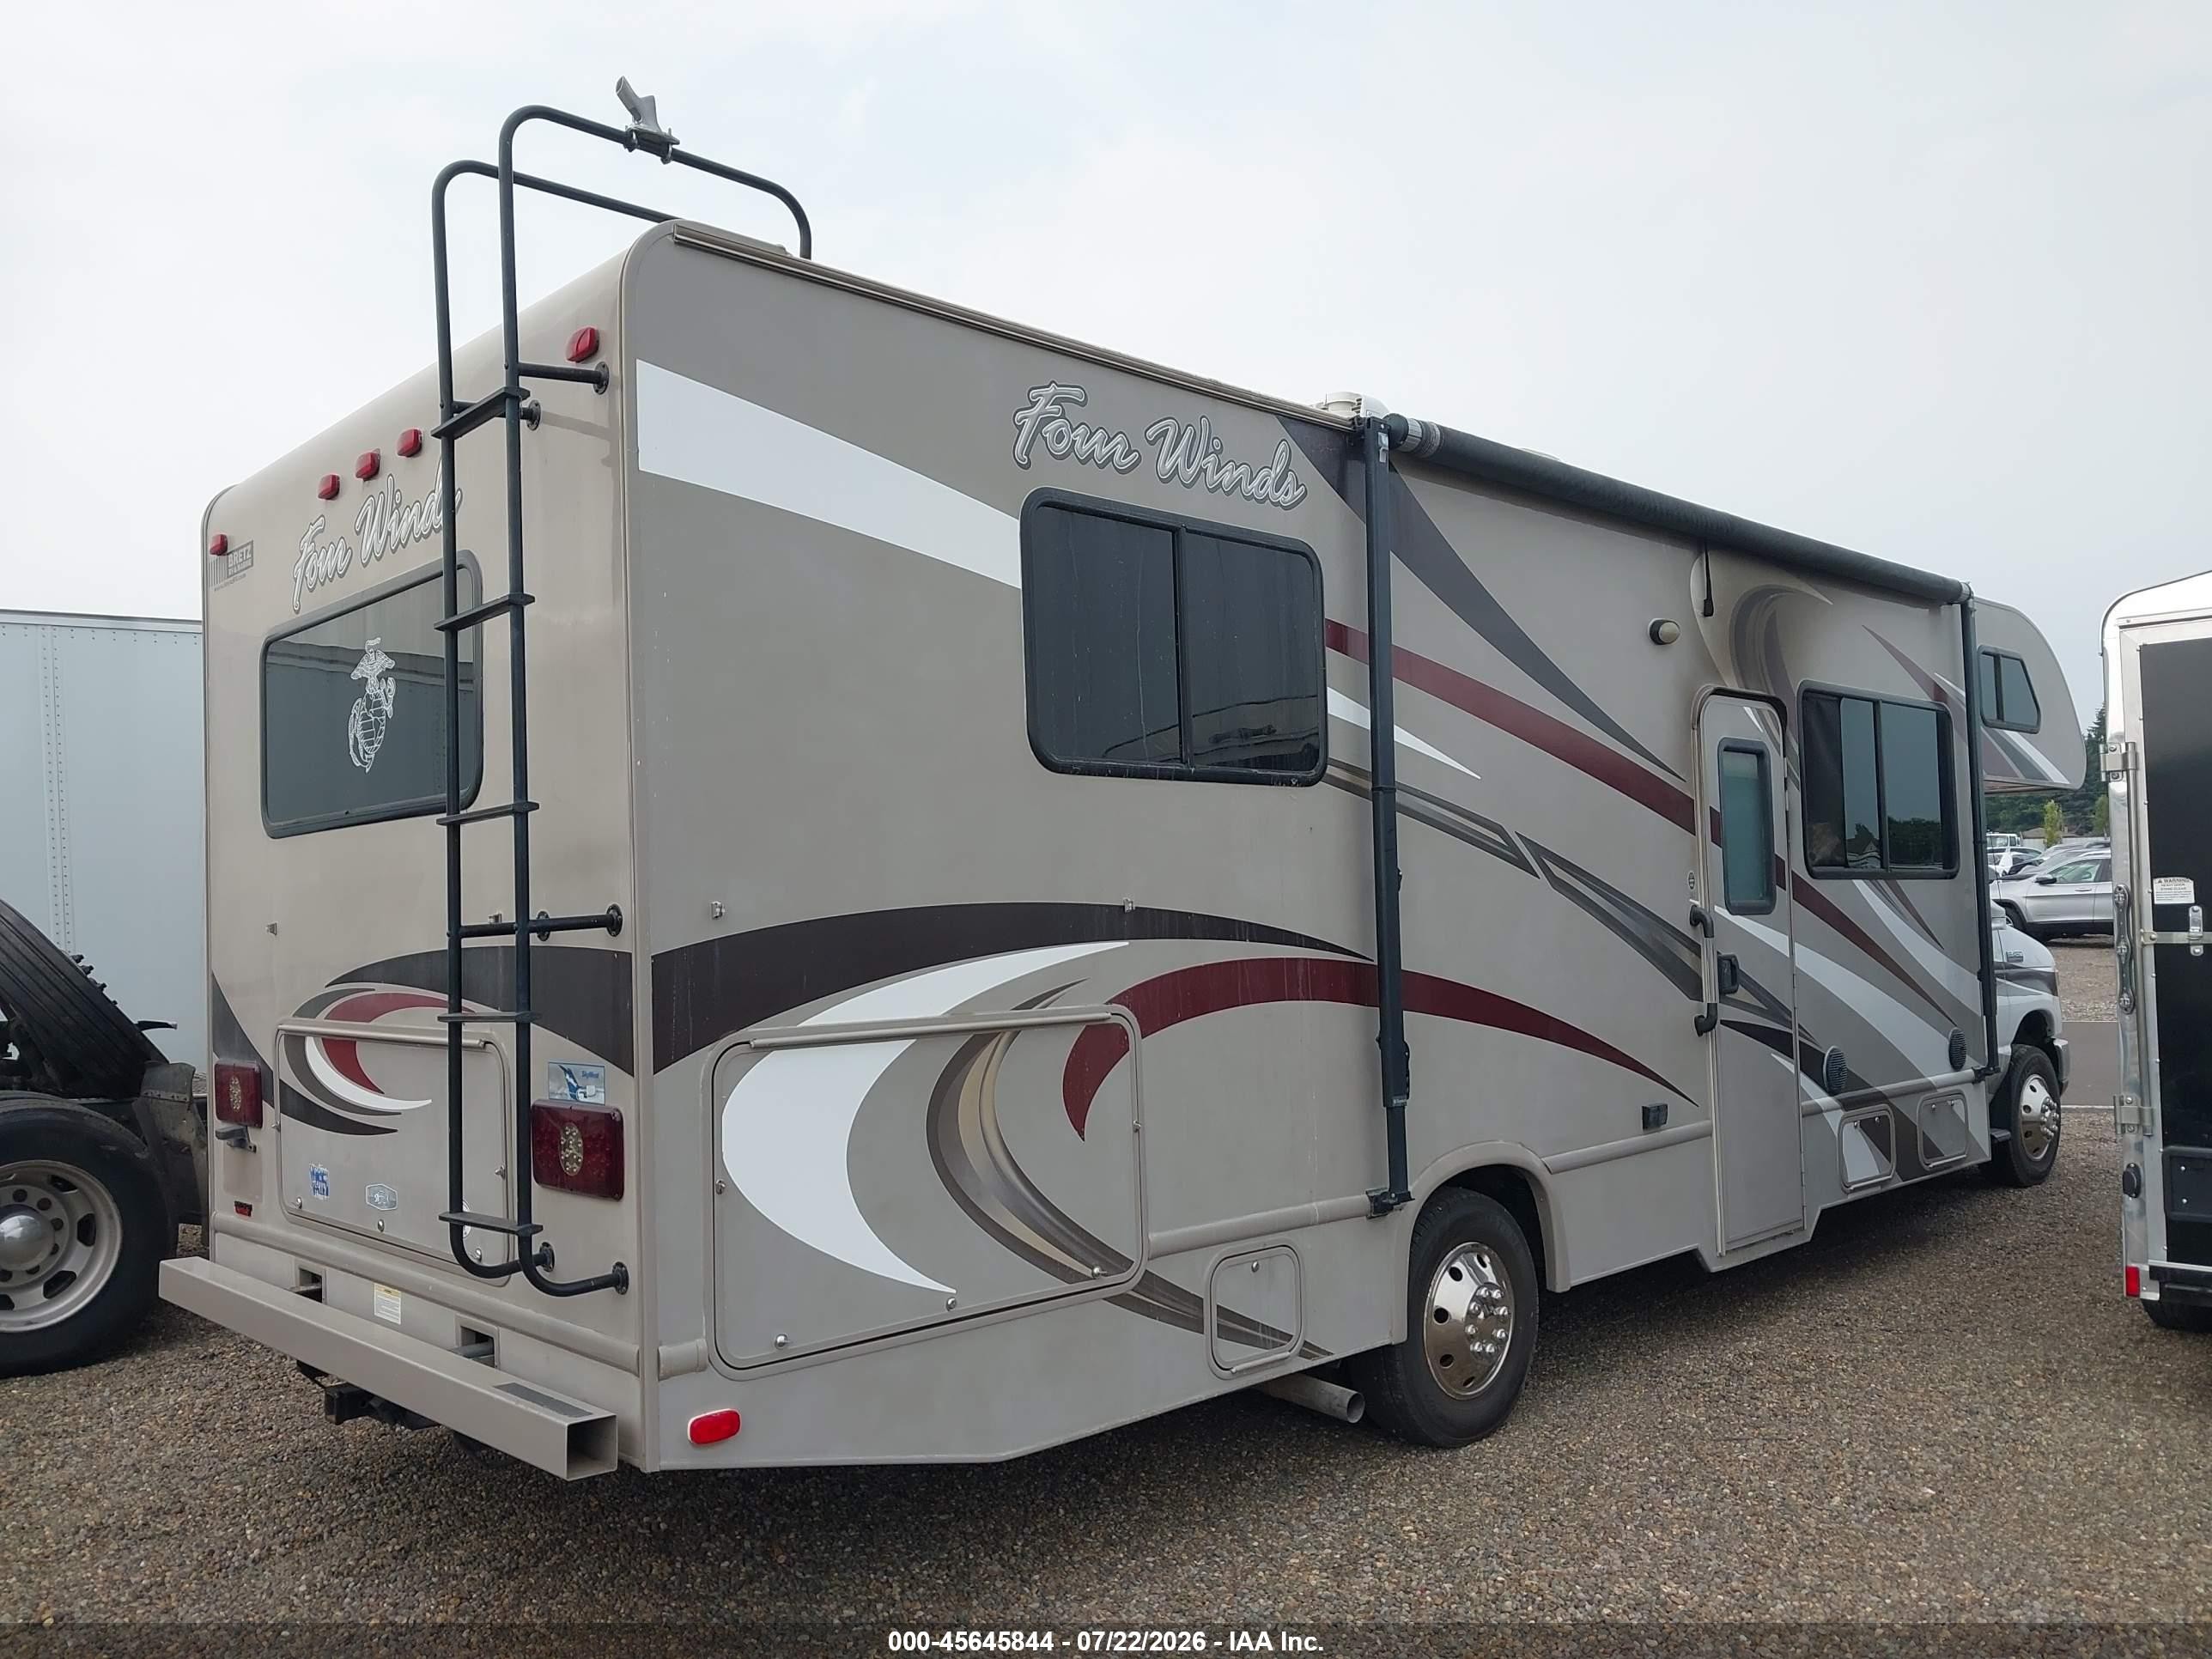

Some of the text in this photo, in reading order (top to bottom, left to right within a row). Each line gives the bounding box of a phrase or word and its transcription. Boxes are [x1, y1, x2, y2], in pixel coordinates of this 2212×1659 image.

[1013, 380, 1308, 510] Four Winds
[228, 544, 252, 568] BRETZ
[292, 452, 463, 614] Four Wind
